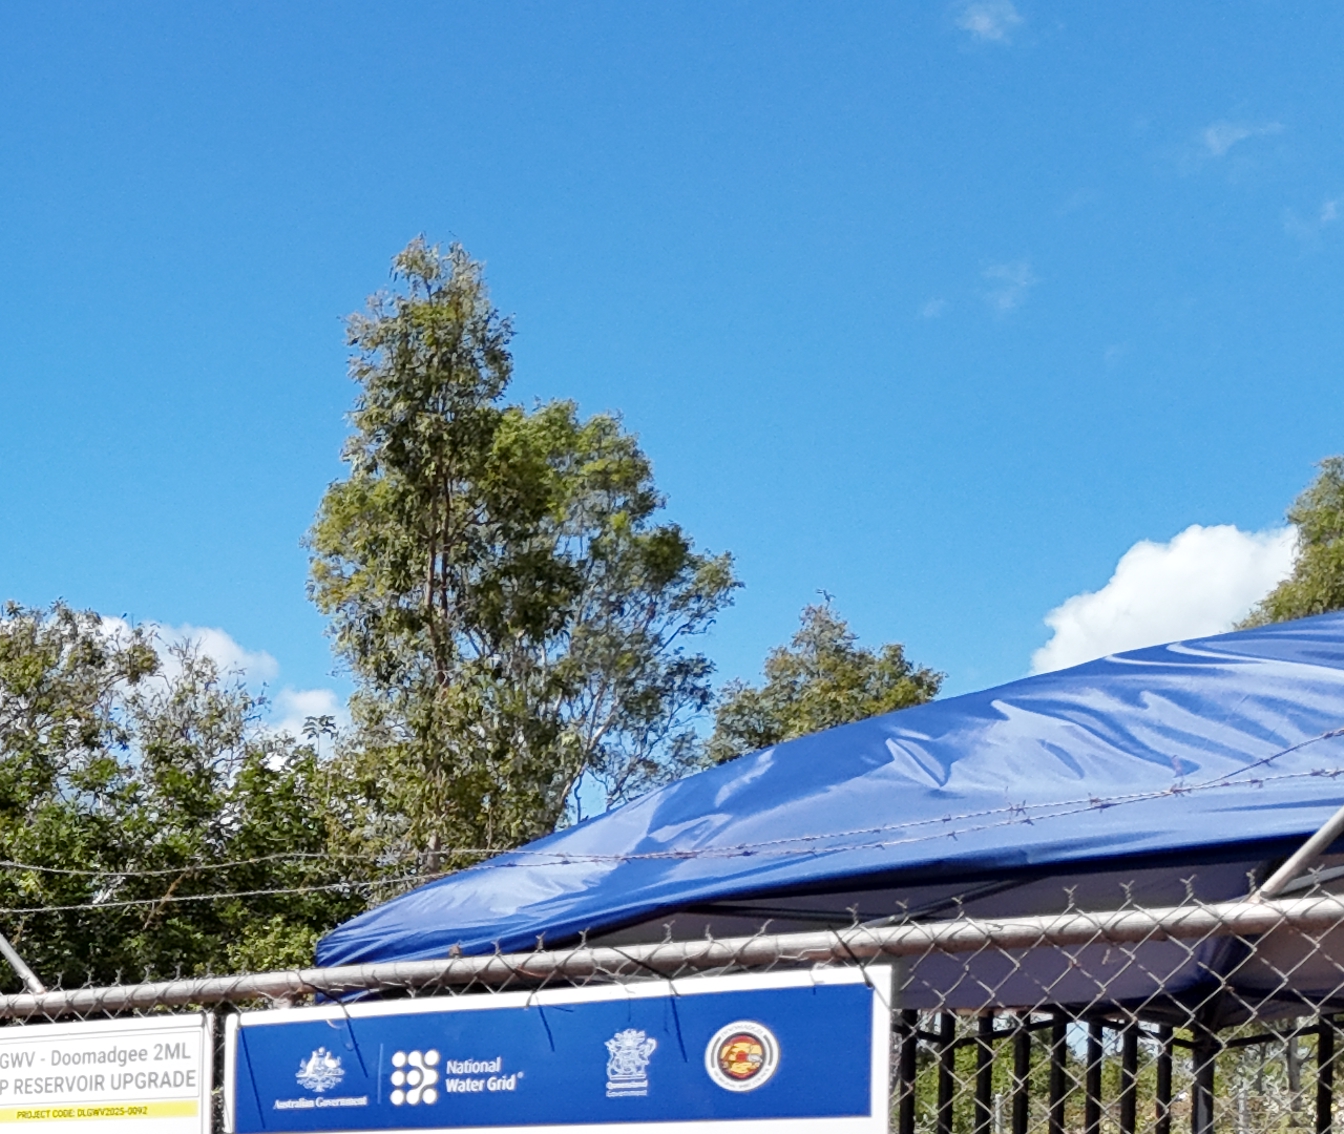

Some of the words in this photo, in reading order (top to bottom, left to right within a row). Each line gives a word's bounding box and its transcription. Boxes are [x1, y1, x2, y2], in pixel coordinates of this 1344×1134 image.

[51, 1045, 148, 1067] Doomadgee
[153, 1042, 191, 1061] 2ML
[446, 1056, 501, 1075] National
[14, 1074, 105, 1095] RESERVOIR
[110, 1069, 196, 1091] UPGRADE
[445, 1077, 485, 1093] Water
[273, 1097, 314, 1110] Australian
[315, 1096, 367, 1108] Government
[17, 1110, 50, 1119] PROJECT
